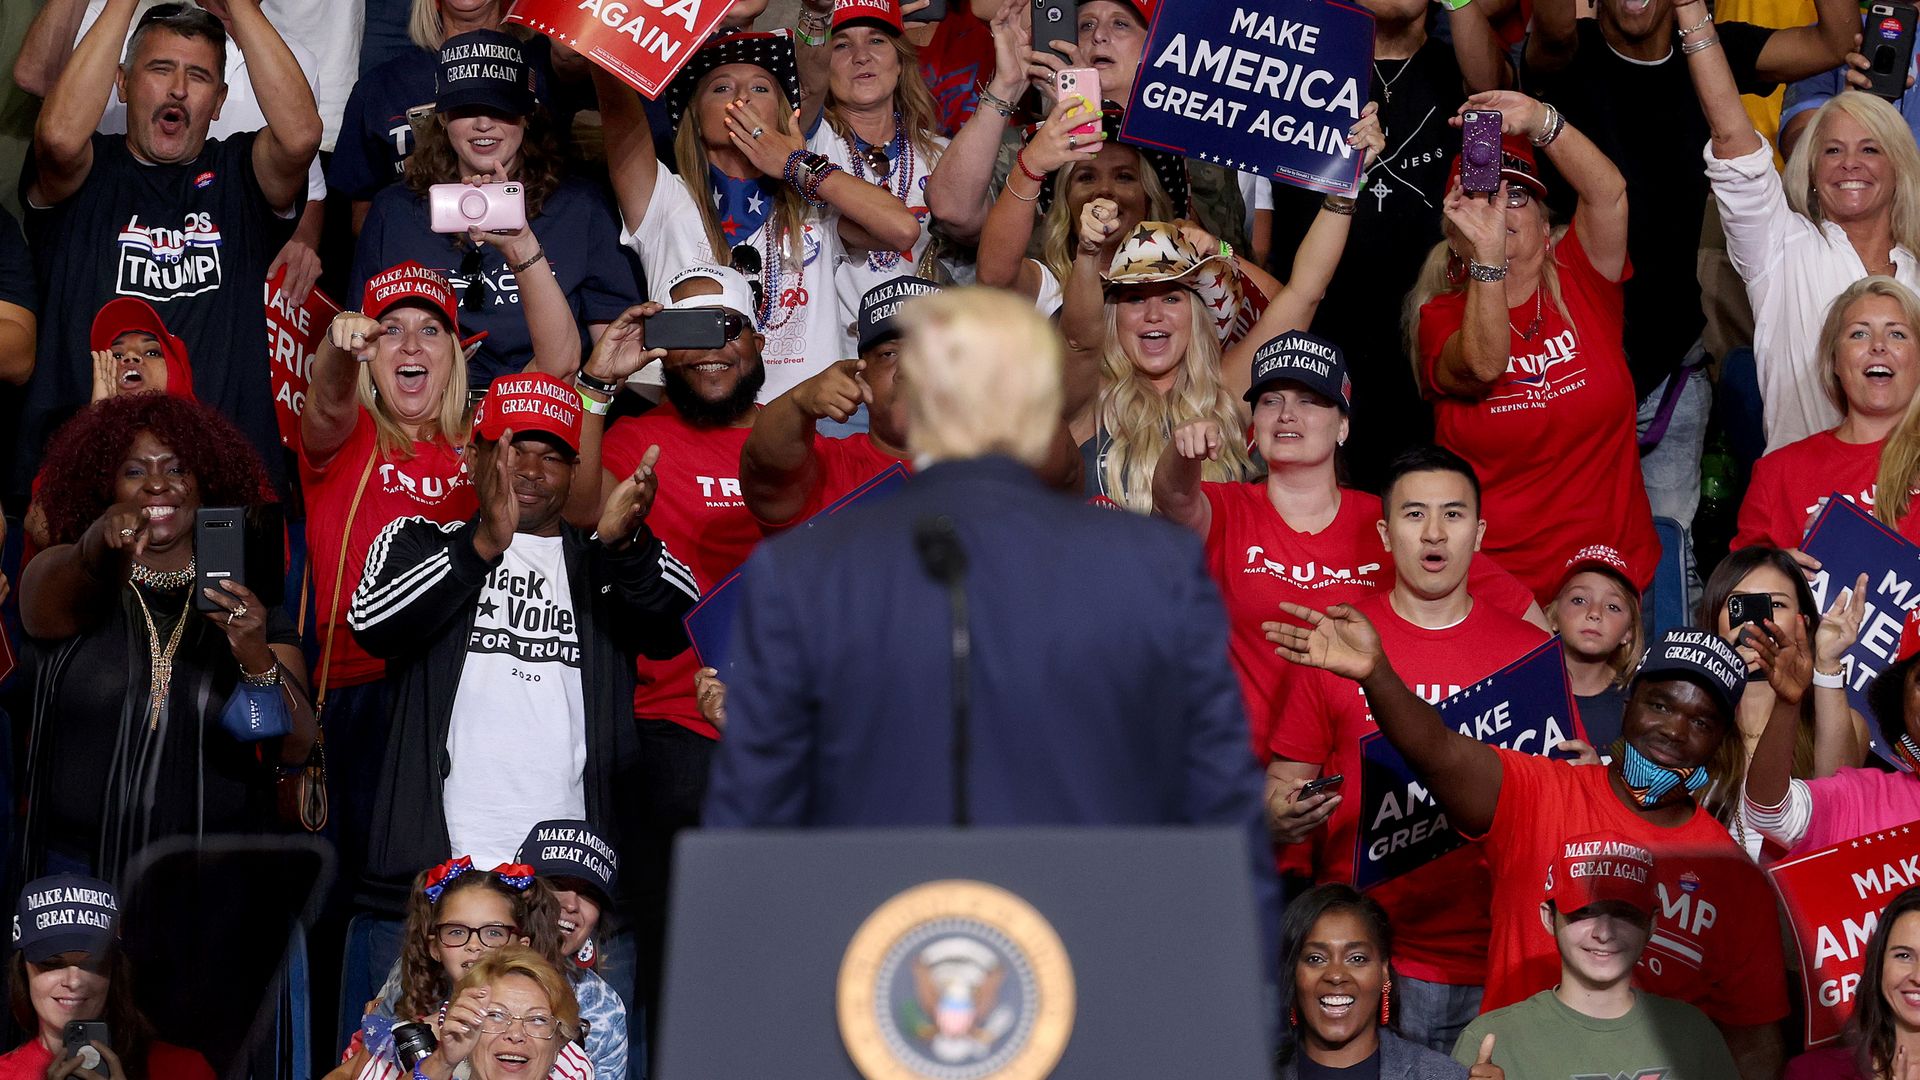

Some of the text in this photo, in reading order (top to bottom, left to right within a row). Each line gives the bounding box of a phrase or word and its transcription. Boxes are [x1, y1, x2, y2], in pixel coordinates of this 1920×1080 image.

[578, 0, 681, 63] AGAIN
[1229, 7, 1320, 54] MAKE
[441, 43, 523, 64] MAKE AMERICA
[447, 63, 518, 82] GREAT AGAIN
[1153, 33, 1359, 119] AMERICA
[1142, 82, 1352, 159] GREAT AGAIN
[126, 255, 215, 290] TRUMP
[165, 253, 182, 264] FO
[370, 269, 402, 290] MAKE
[403, 266, 451, 295] AMERICA
[376, 281, 412, 302] GREAT
[414, 282, 446, 305] AGAIN
[864, 285, 894, 310] MAKE
[870, 301, 905, 324] GREAT
[1255, 337, 1337, 365] MAKE AMERICA
[1258, 354, 1330, 378] GREAT AGAIN
[496, 380, 581, 411] MAKE AMERICA
[1490, 402, 1529, 414] KEEPING
[1559, 378, 1587, 395] GREAT
[502, 398, 575, 427] GREAT AGAIN
[696, 475, 743, 497] TR
[1243, 566, 1267, 574] MAKE
[1269, 571, 1309, 589] AMERICA
[1312, 579, 1341, 589] GREAT
[1246, 545, 1380, 582] TRUMP
[486, 567, 545, 599] lack
[469, 632, 581, 662] FOR TRUMP
[1664, 631, 1746, 679] MAKE AMERICA
[511, 668, 541, 682] 2020
[1664, 646, 1738, 690] GREAT AGAIN
[537, 828, 617, 870] MAKE AMERICA
[1563, 841, 1654, 867] MAKE AMERICA
[541, 846, 583, 863] GREAT
[582, 853, 613, 884] AGAIN
[1569, 861, 1648, 884] GREAT AGAIN
[27, 887, 118, 911] MAKE AMERICA
[36, 909, 112, 930] GREAT AGAIN
[1813, 907, 1885, 970] AM
